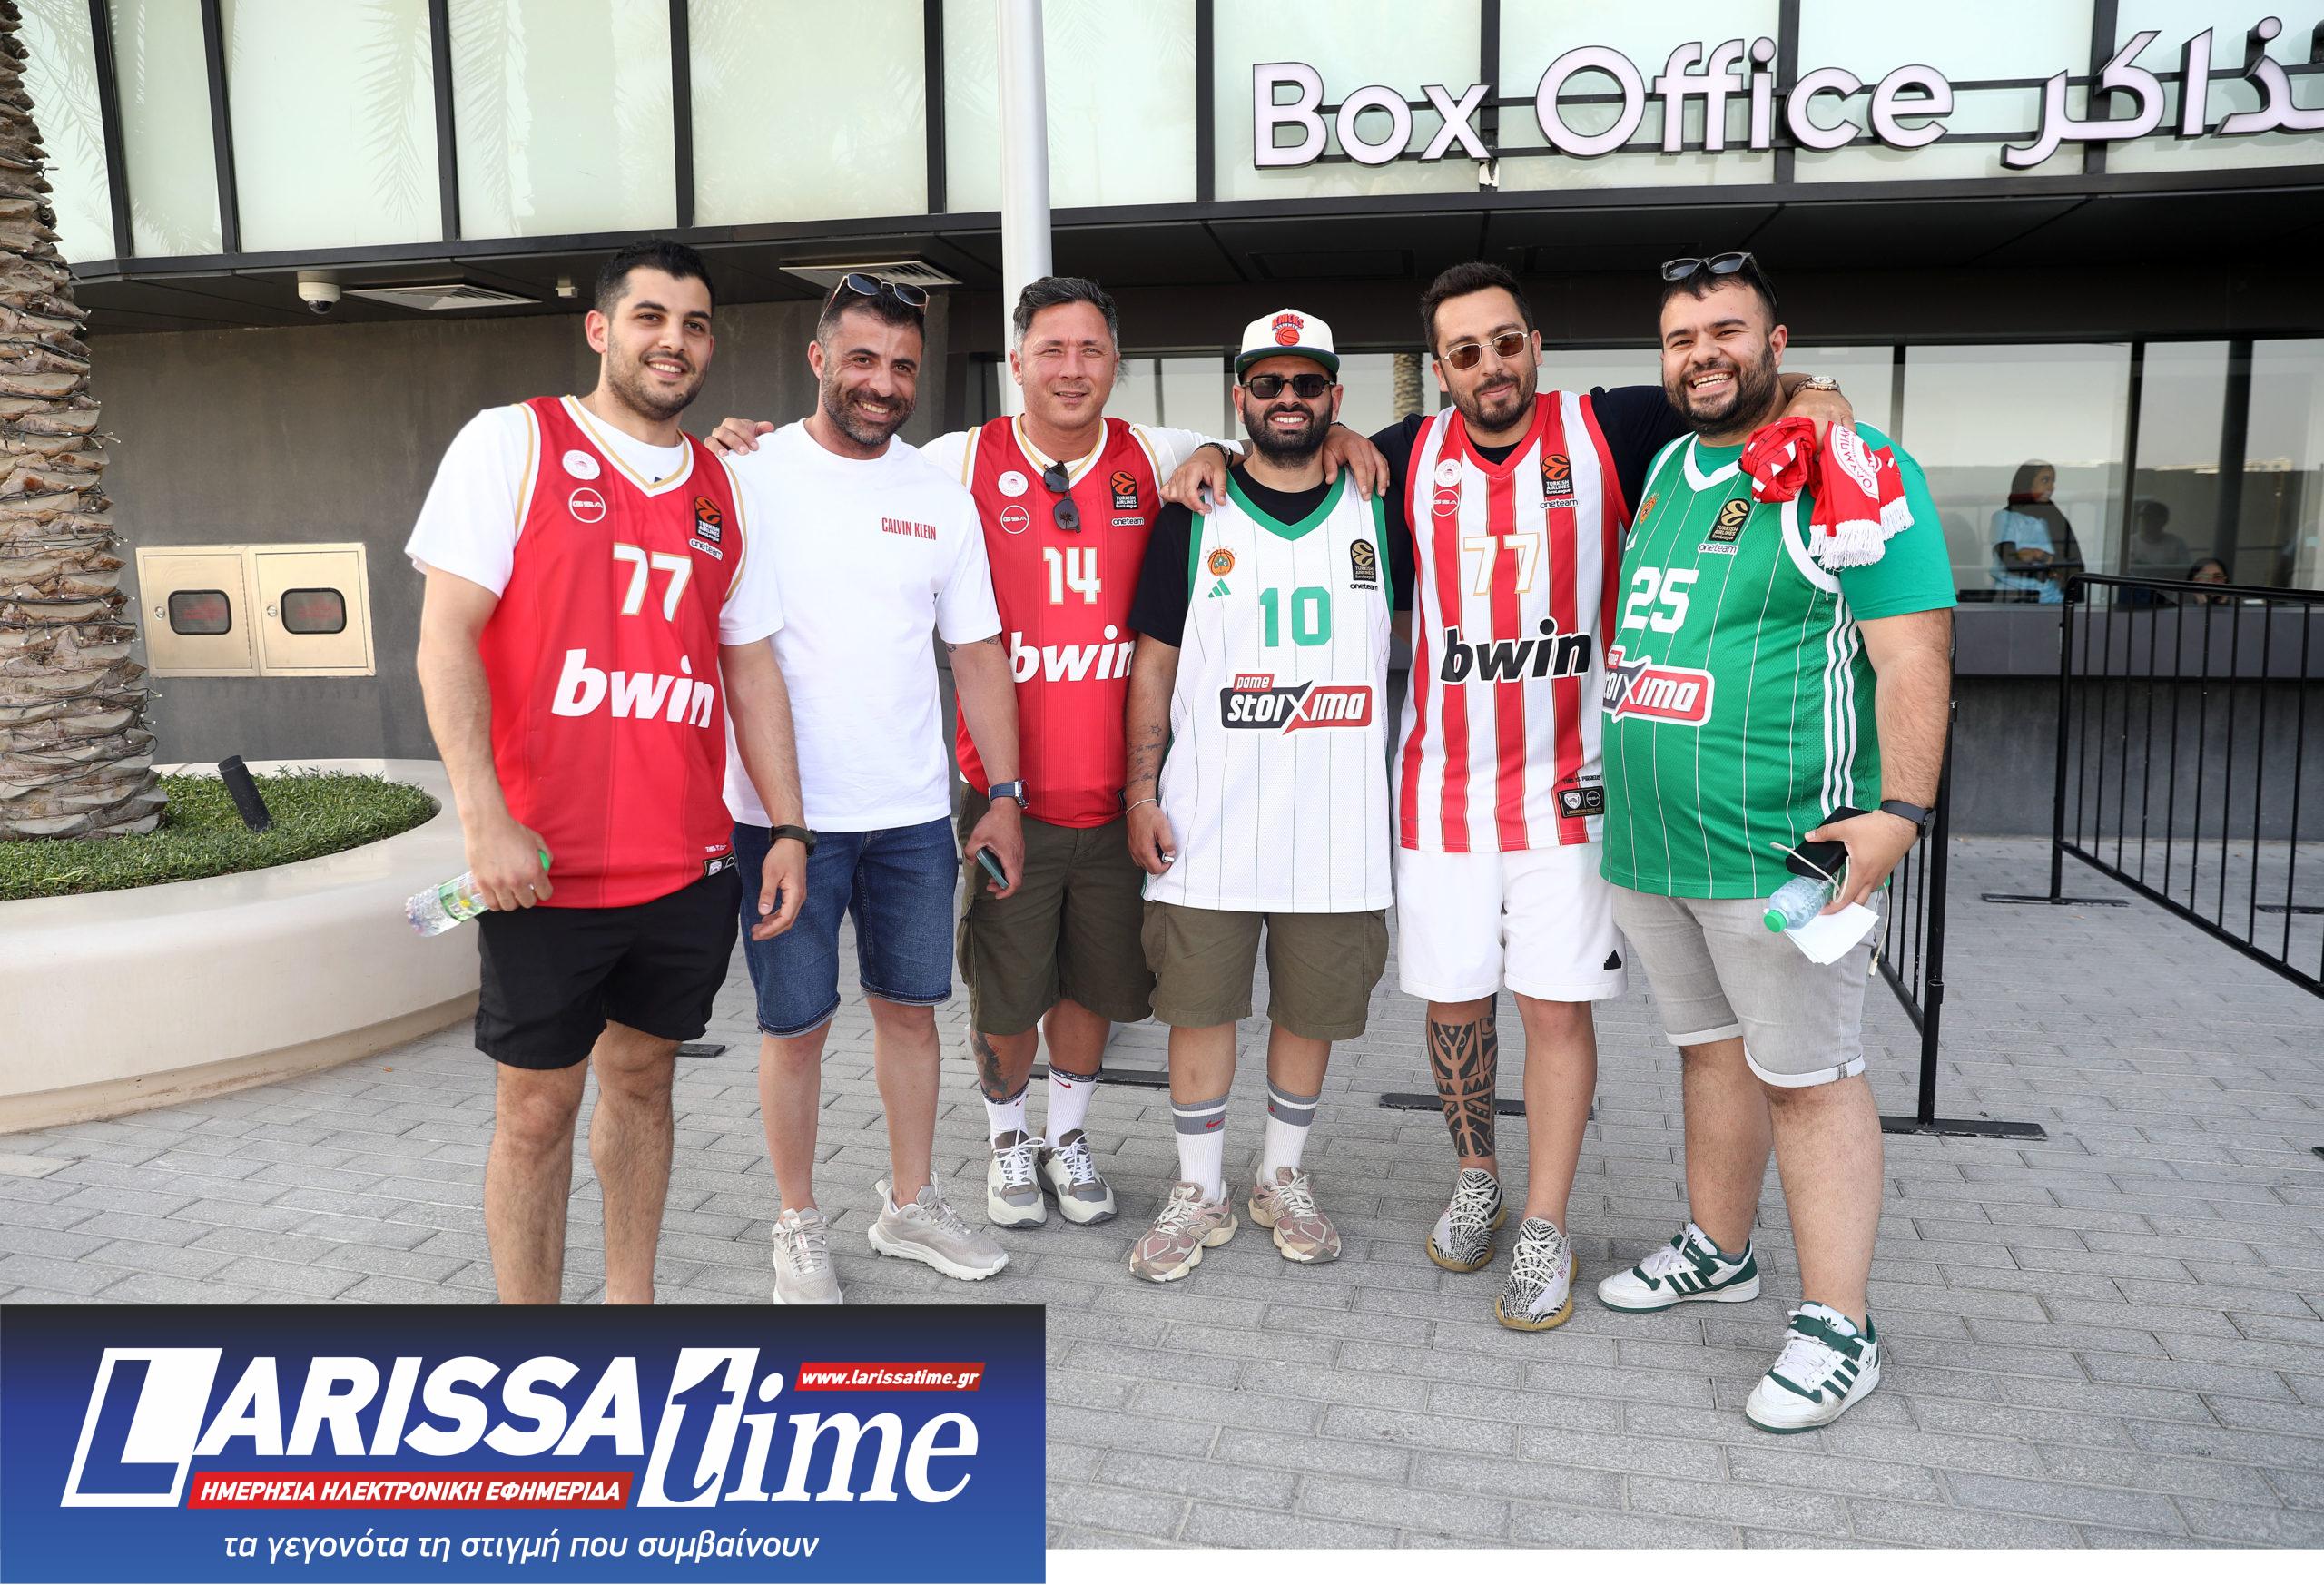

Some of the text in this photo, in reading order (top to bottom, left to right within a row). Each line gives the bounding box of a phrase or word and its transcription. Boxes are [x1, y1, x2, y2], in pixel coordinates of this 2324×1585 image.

[1253, 36, 1954, 170] Box Office
[2000, 15, 2324, 171] ذاكر
[1272, 313, 1305, 330] KNICKS
[881, 517, 936, 541] CALVIN KLEIN
[1113, 517, 1144, 526] oneteam
[1540, 499, 1579, 509] oneteam
[691, 538, 723, 560] oneteam
[1043, 546, 1102, 605] 14
[1462, 532, 1541, 596] 77
[1699, 544, 1738, 554] oneteam
[613, 542, 693, 624] 77
[1349, 583, 1379, 592] oneteam
[1620, 566, 1699, 634] 25
[1259, 586, 1332, 647] 10
[1009, 624, 1136, 684] bwin
[1441, 618, 1591, 684] bwin
[550, 648, 715, 729] bwin
